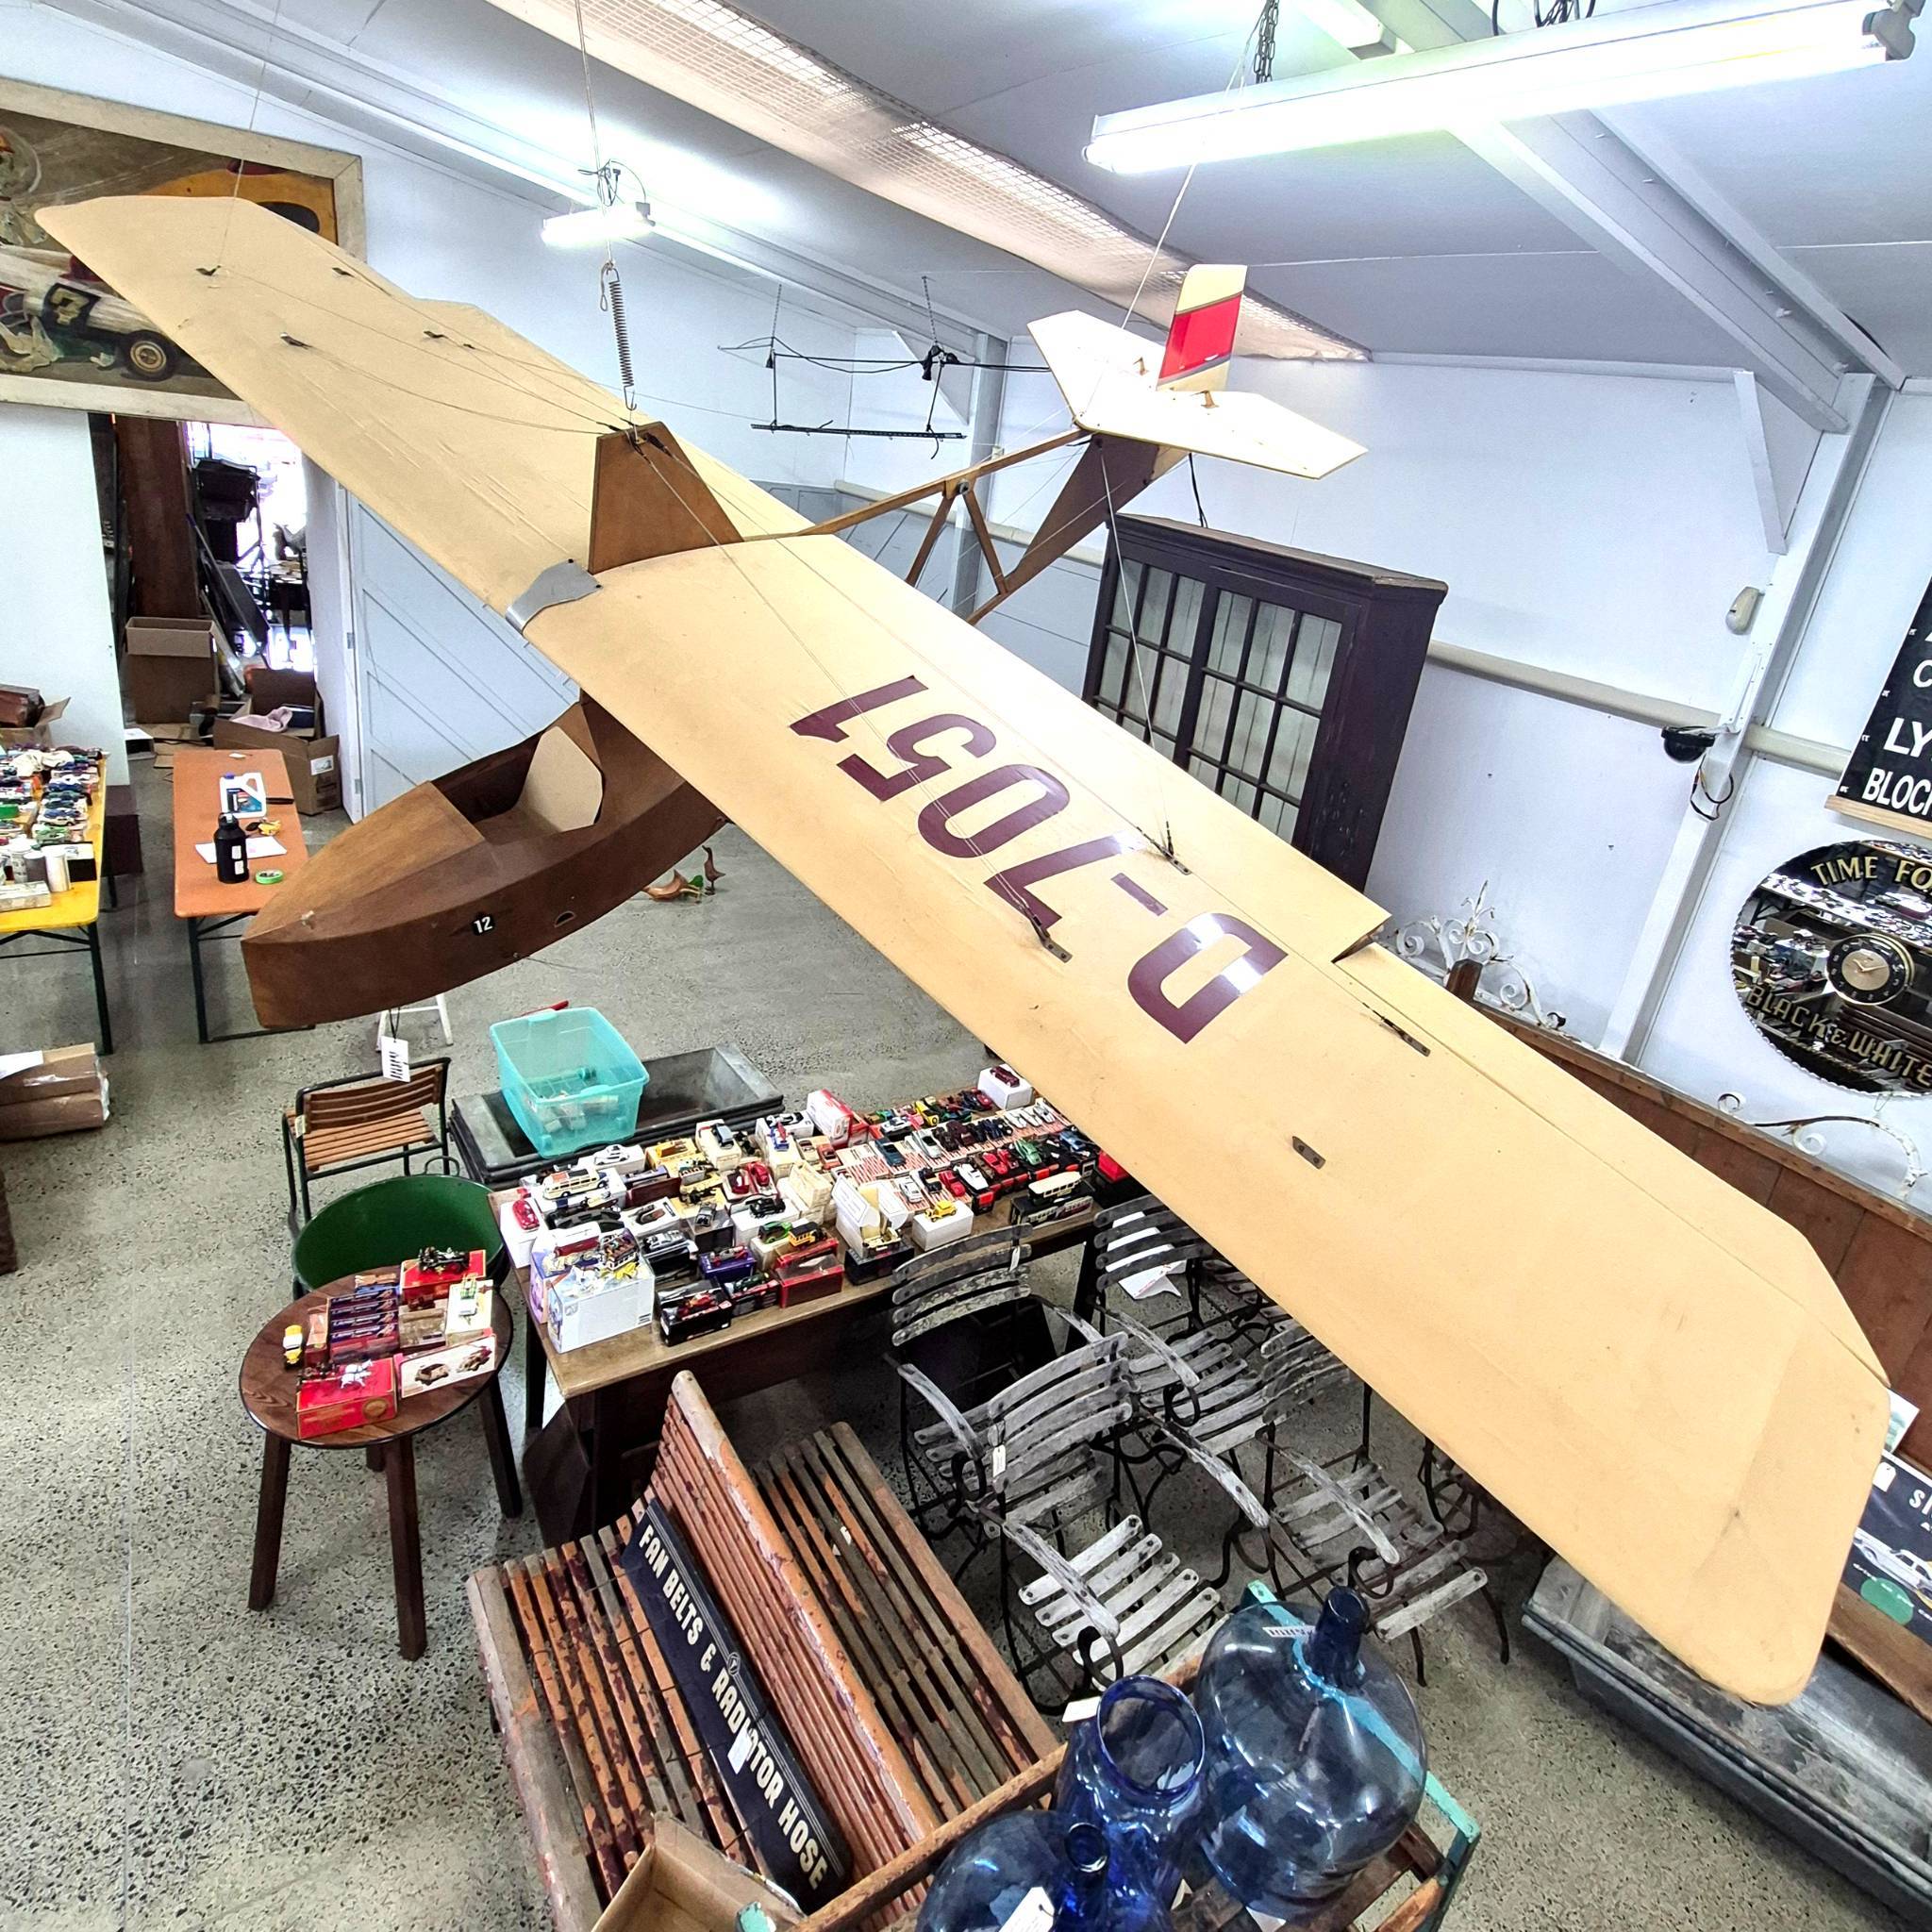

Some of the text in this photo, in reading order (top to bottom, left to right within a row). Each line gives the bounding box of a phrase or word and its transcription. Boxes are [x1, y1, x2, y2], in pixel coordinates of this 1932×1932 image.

[1810, 856, 1878, 886] TIME
[474, 916, 493, 934] 12
[1746, 984, 1829, 1039] BLACK
[1848, 1030, 1932, 1087] WHITE
[639, 1524, 669, 1579] FAN
[662, 1570, 704, 1646] BELTS
[699, 1643, 717, 1672] &
[777, 1796, 829, 1890] HOSE
